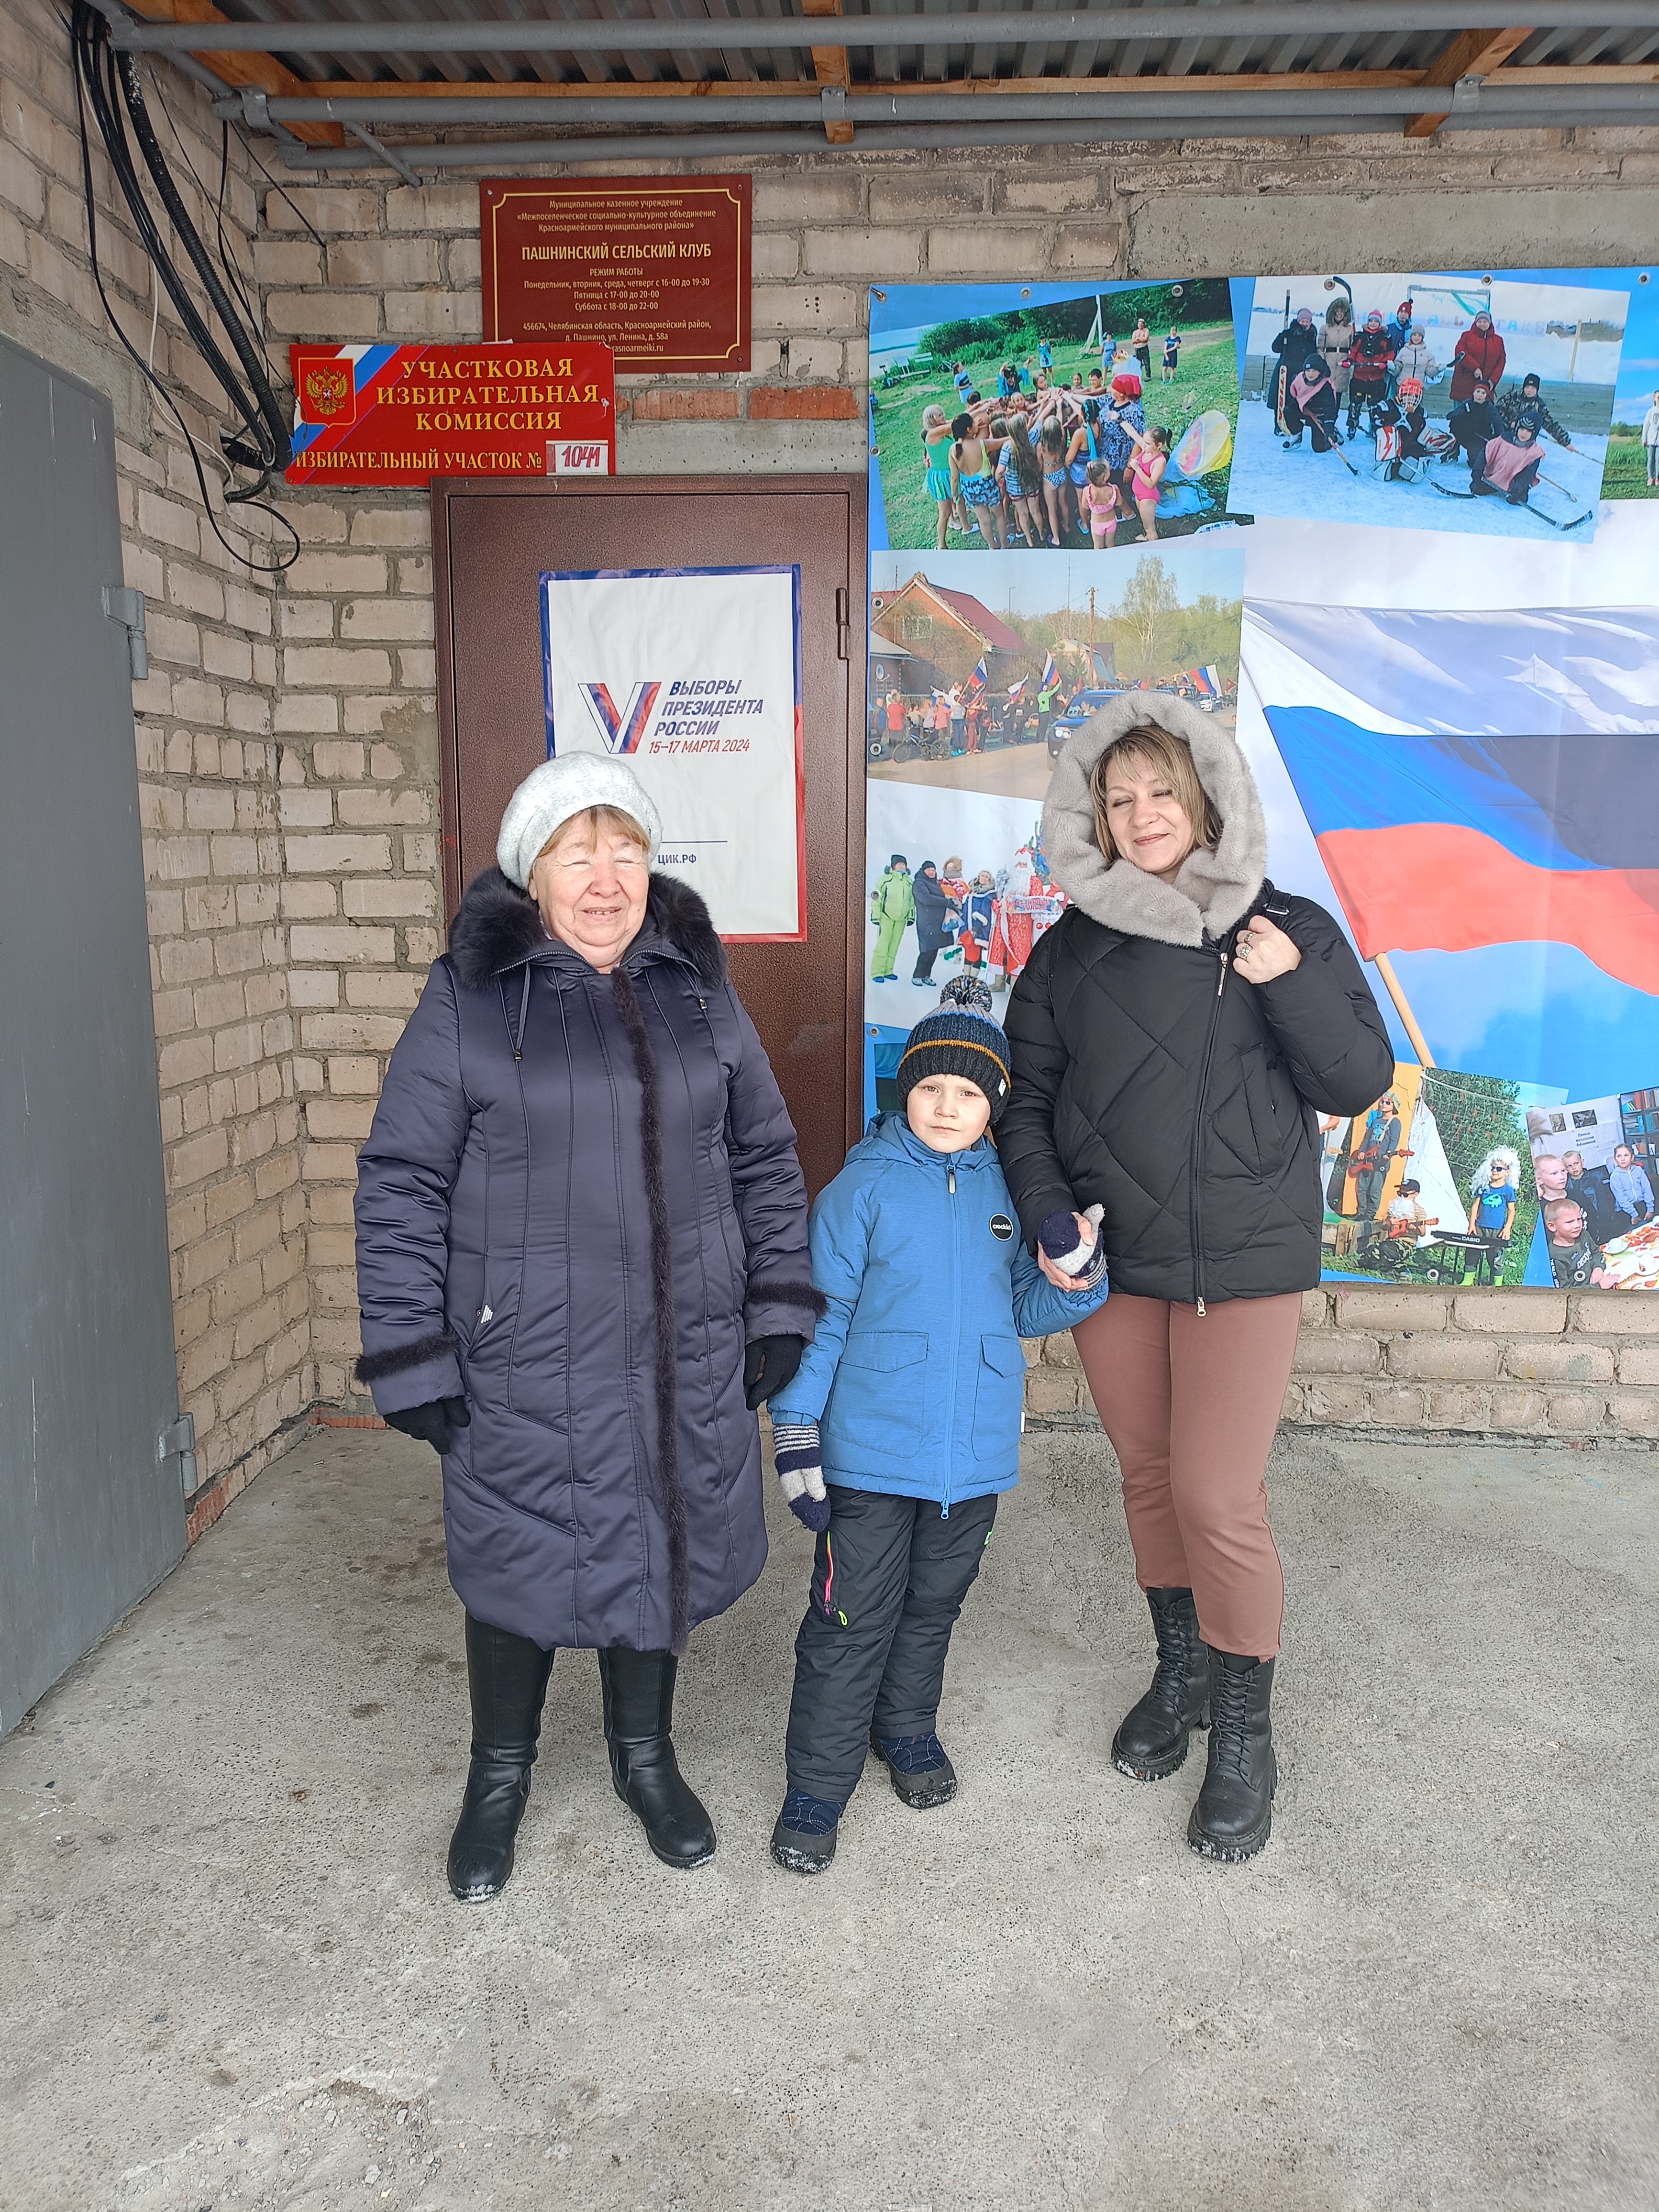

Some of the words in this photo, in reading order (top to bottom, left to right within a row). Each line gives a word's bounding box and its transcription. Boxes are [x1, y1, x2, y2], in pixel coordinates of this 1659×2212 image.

[549, 200, 605, 210] Муниципальное
[641, 199, 683, 209] учреждение
[589, 211, 668, 221] социально-культурное
[670, 210, 716, 219] объединение
[539, 222, 603, 233] Красноармейского
[605, 223, 663, 232] муниципального
[664, 221, 694, 232] района»
[522, 242, 608, 260] ПАШНИНСКИЙ
[612, 241, 675, 259] СЕЛЬСКИЙ
[679, 243, 711, 257] КЛУБ
[524, 281, 572, 289] Понедельник,
[573, 280, 603, 289] вторник,
[604, 280, 626, 289] среда,
[627, 280, 654, 289] четверг
[681, 279, 690, 287] до
[574, 291, 603, 300] Пятница
[629, 291, 638, 299] до
[575, 302, 602, 312] Суббота
[629, 303, 638, 311] до
[523, 322, 547, 332] 456674,
[548, 321, 593, 330] Челябинская
[594, 321, 623, 331] область,
[625, 320, 686, 331] Красноармейский
[688, 319, 711, 330] район,
[574, 333, 607, 342] Пашнино,
[619, 333, 647, 342] Ленина,
[610, 343, 664, 352] rasnoarmeiki.ru
[401, 359, 573, 379] УЧАСТКОВАЯ
[376, 385, 599, 405] ИЗБИРАТЕЛЬНАЯ
[416, 412, 562, 431] КОМИССИЯ
[296, 448, 439, 469] ИЗБИРАТЕЛЬНЫЙ
[444, 452, 522, 469] УЧАСТОК
[526, 452, 542, 468] №
[562, 445, 600, 467] 1041
[669, 680, 742, 696] ВЫБОРЫ
[661, 699, 764, 717] ПРЕЗИДЕНТА
[654, 720, 720, 736] РОССИИ
[681, 739, 719, 753] МАРТА
[721, 739, 750, 752] 2024
[658, 854, 697, 865] ЦИК.РФ
